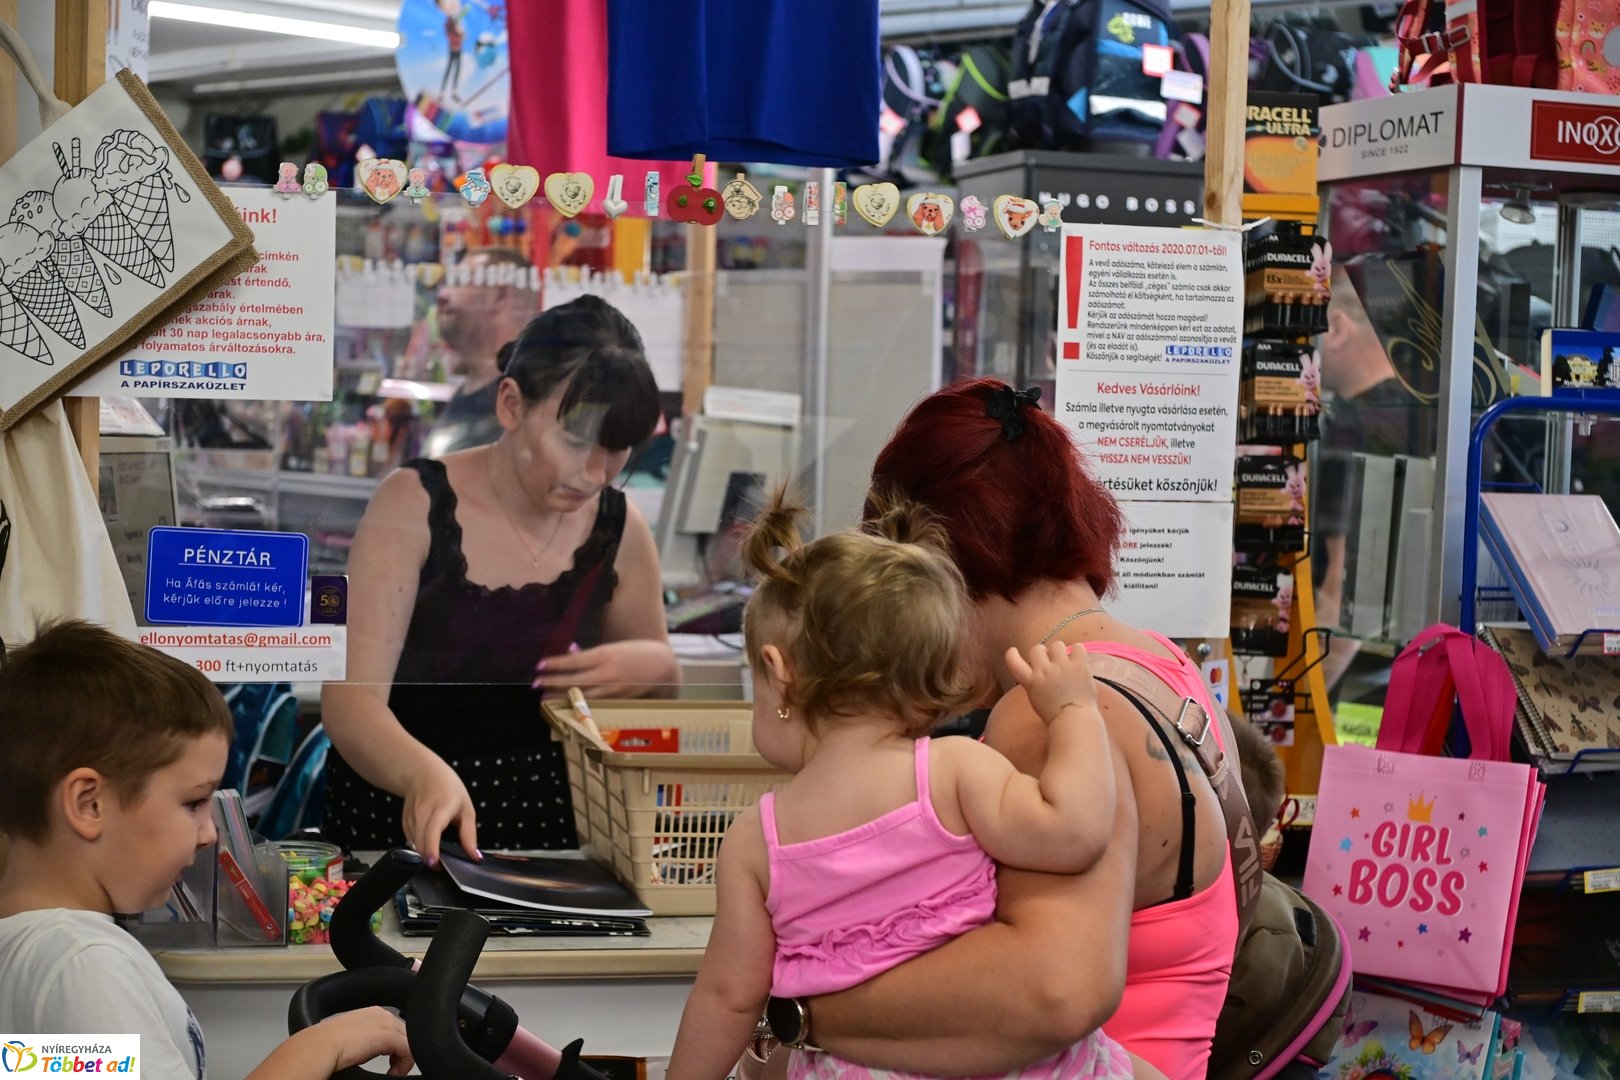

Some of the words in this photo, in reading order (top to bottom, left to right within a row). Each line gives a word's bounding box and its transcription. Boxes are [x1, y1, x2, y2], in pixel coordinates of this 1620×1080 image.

[1247, 106, 1311, 123] RACELL
[1266, 122, 1311, 136] ULTRA
[1332, 111, 1444, 148] DIPLOMAT
[1361, 148, 1386, 160] SINCE
[1126, 196, 1195, 215] BOSS
[236, 207, 277, 224] ink!
[1090, 241, 1120, 251] Fontos
[1123, 242, 1159, 253] változás
[1162, 244, 1226, 256] 2020.07.01-től!
[1267, 252, 1311, 264] DURACELL
[244, 276, 291, 288] értendő,
[1186, 294, 1225, 302] tartalmazza
[240, 303, 303, 314] értelmében
[195, 315, 233, 325] akciós
[237, 316, 272, 328] árnak,
[1088, 311, 1109, 321] Kérjük
[1088, 321, 1128, 329] Rendszerünk
[1130, 323, 1178, 333] mindenképpen
[1180, 324, 1191, 332] kéri
[170, 328, 183, 337] 30
[187, 331, 208, 339] nap
[212, 330, 301, 343] legalacsonyabb
[305, 333, 326, 343] ára,
[140, 340, 205, 352] folyamatos
[210, 342, 296, 354] árváltozásokra.
[1087, 353, 1119, 362] Köszönjük
[120, 360, 247, 378] LEPORELLO
[1256, 361, 1300, 372] DURACELL
[121, 380, 129, 388] A
[133, 379, 246, 391] PAPÍRSZAKÜZLET
[1097, 383, 1136, 394] Kedves
[1140, 383, 1200, 396] Vásárlóink!
[1066, 402, 1097, 413] Számla
[1099, 403, 1124, 413] illetve
[1126, 405, 1155, 418] nyugta
[1158, 405, 1197, 415] vásárlása
[1199, 406, 1228, 416] esetén,
[1087, 420, 1139, 432] megvásárolt
[1141, 422, 1215, 434] nyomtatványokat
[1098, 437, 1116, 446] NEM
[1119, 437, 1168, 449] CSERÉLJÜK,
[1171, 440, 1195, 448] illetve
[1100, 455, 1128, 463] VISSZA
[1131, 455, 1149, 463] NEM
[1152, 455, 1191, 465] VESSZÜK!
[1242, 474, 1285, 482] DURACELL
[1156, 478, 1217, 494] köszönjük!
[184, 545, 271, 566] PÉNZTÁR
[166, 578, 181, 588] Ha
[186, 577, 212, 589] Áfás
[216, 581, 260, 591] számlát
[264, 582, 285, 594] kér,
[1233, 582, 1274, 592] DURACELL
[164, 594, 200, 605] kérjük
[204, 596, 234, 606] előre
[239, 598, 279, 608] jelezze
[140, 633, 331, 647] ellonyomtatas@gmail.com
[196, 660, 221, 672] 300
[226, 660, 317, 674] ft+nyomtatás
[1372, 821, 1452, 865] GIRL
[1234, 816, 1259, 907] FILA
[1348, 860, 1465, 916] BOSS
